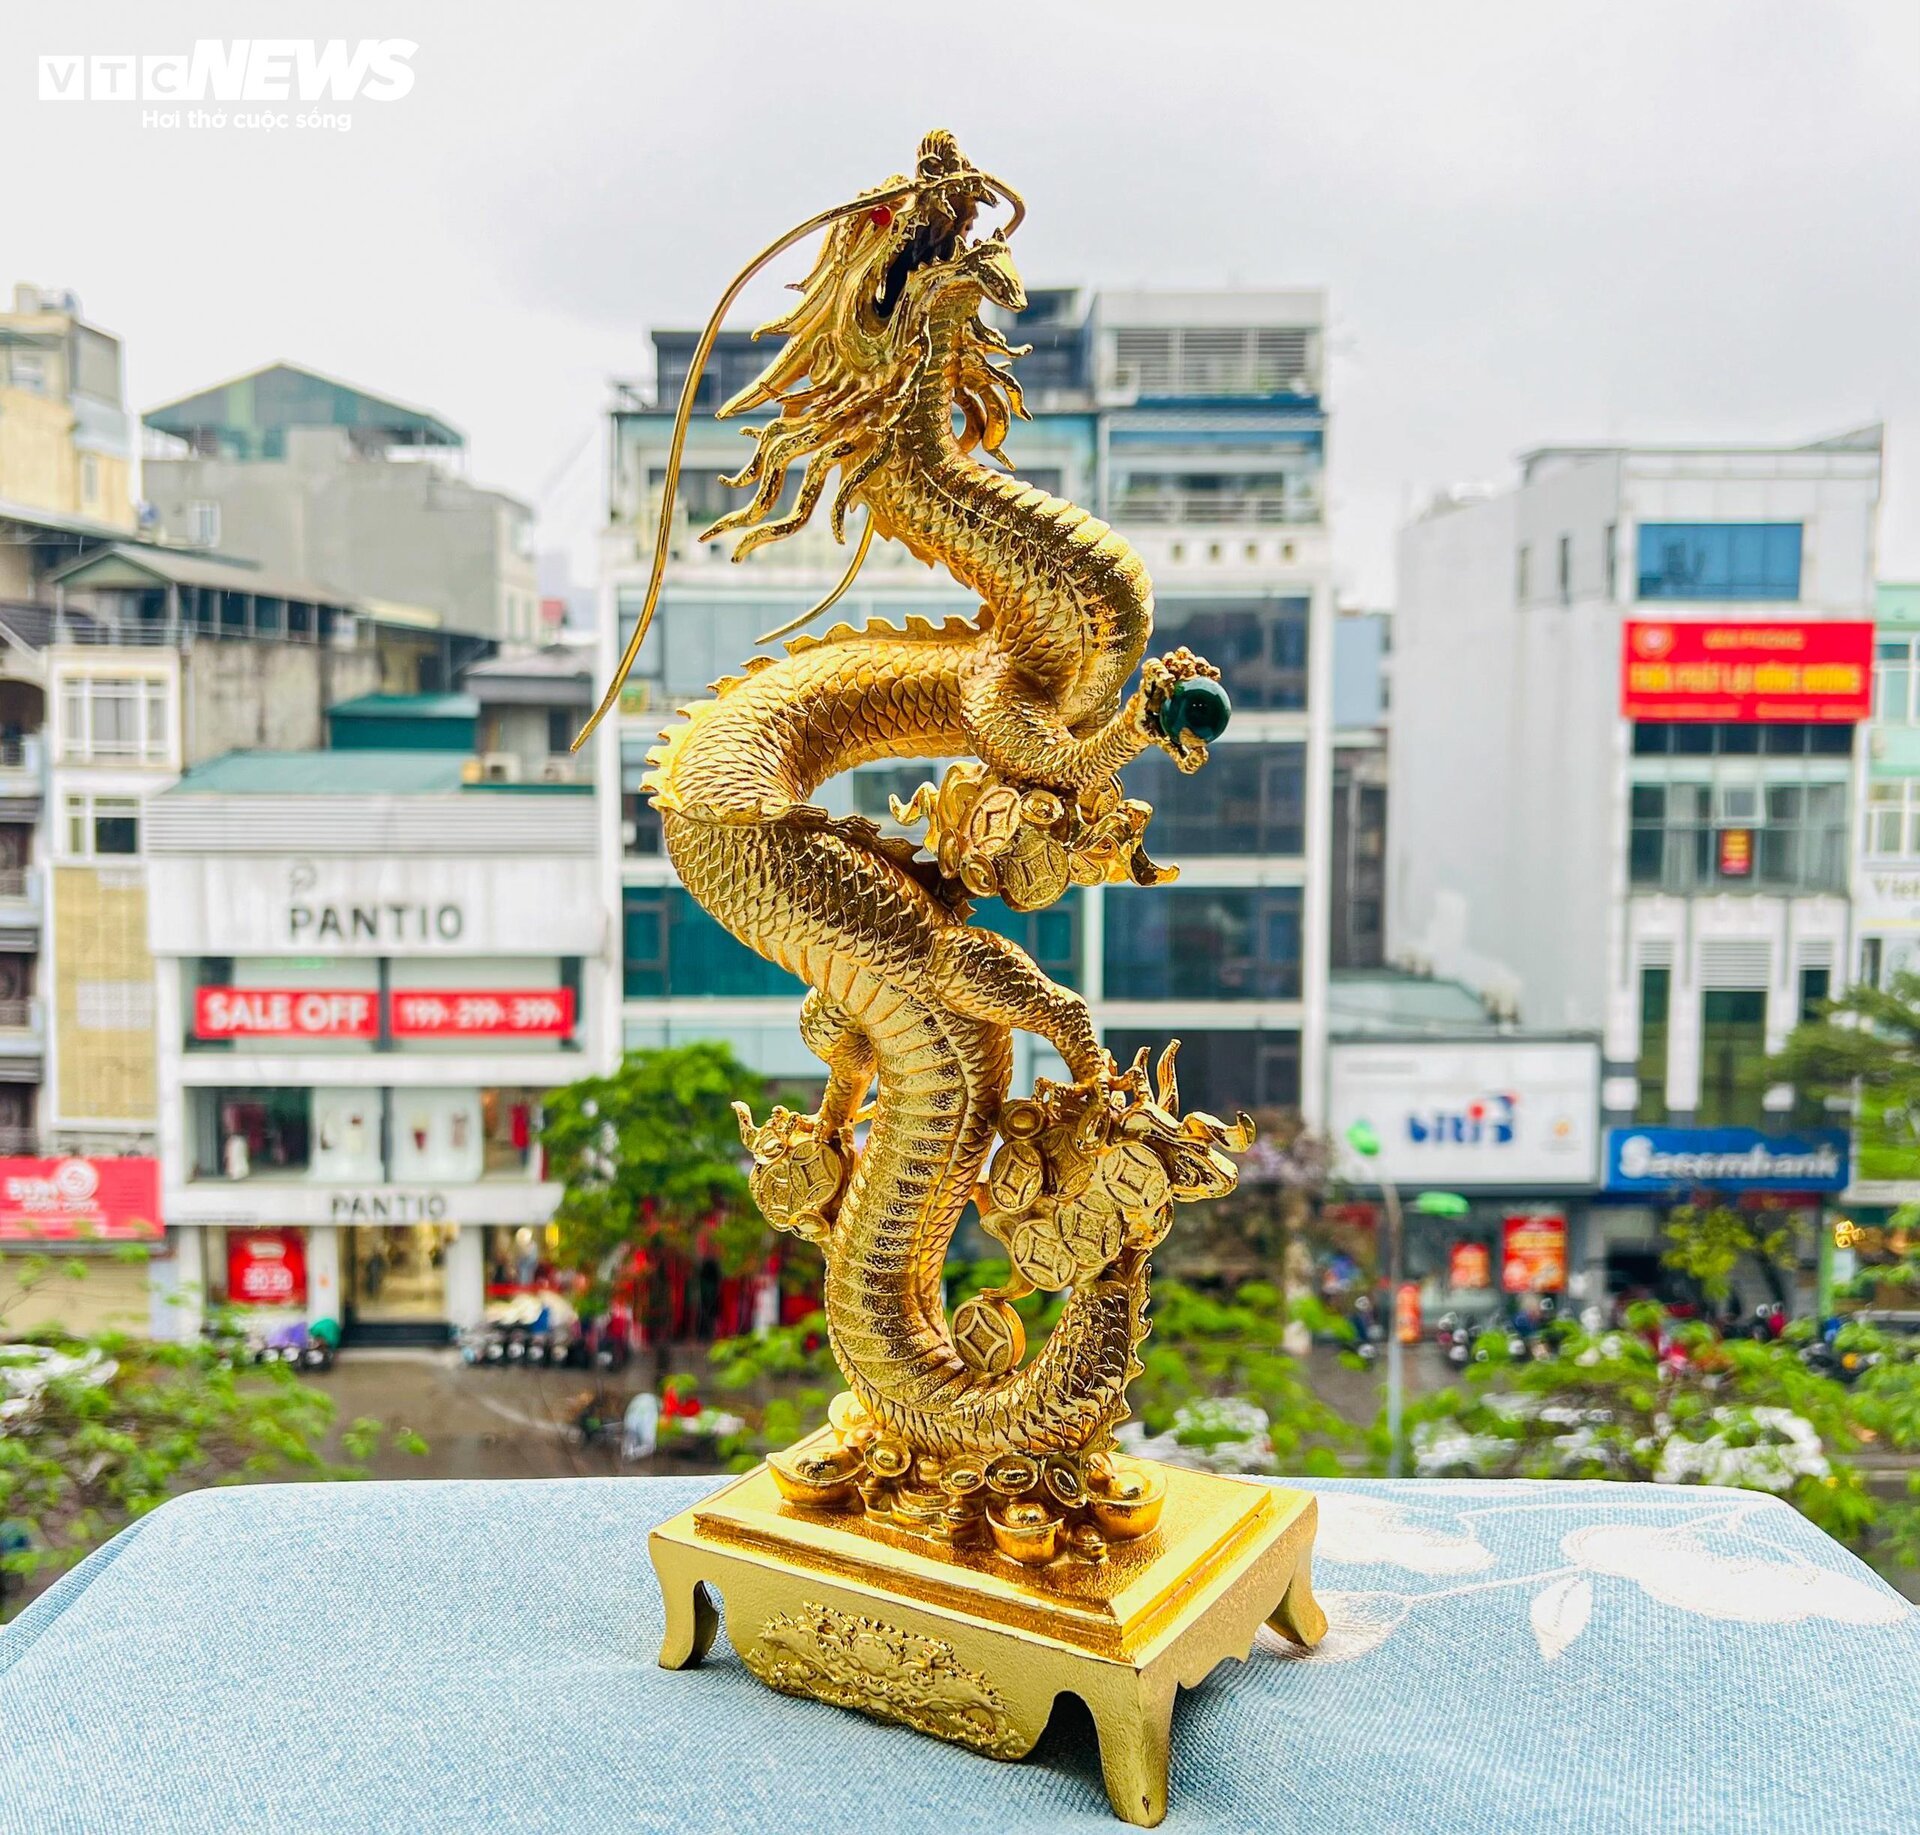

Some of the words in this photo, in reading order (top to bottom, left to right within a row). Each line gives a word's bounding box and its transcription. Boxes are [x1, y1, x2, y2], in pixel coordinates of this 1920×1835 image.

[289, 902, 463, 941] PANTIO
[207, 993, 292, 1031] SALE
[300, 993, 369, 1031] OFF
[331, 1194, 447, 1219] PANTIO
